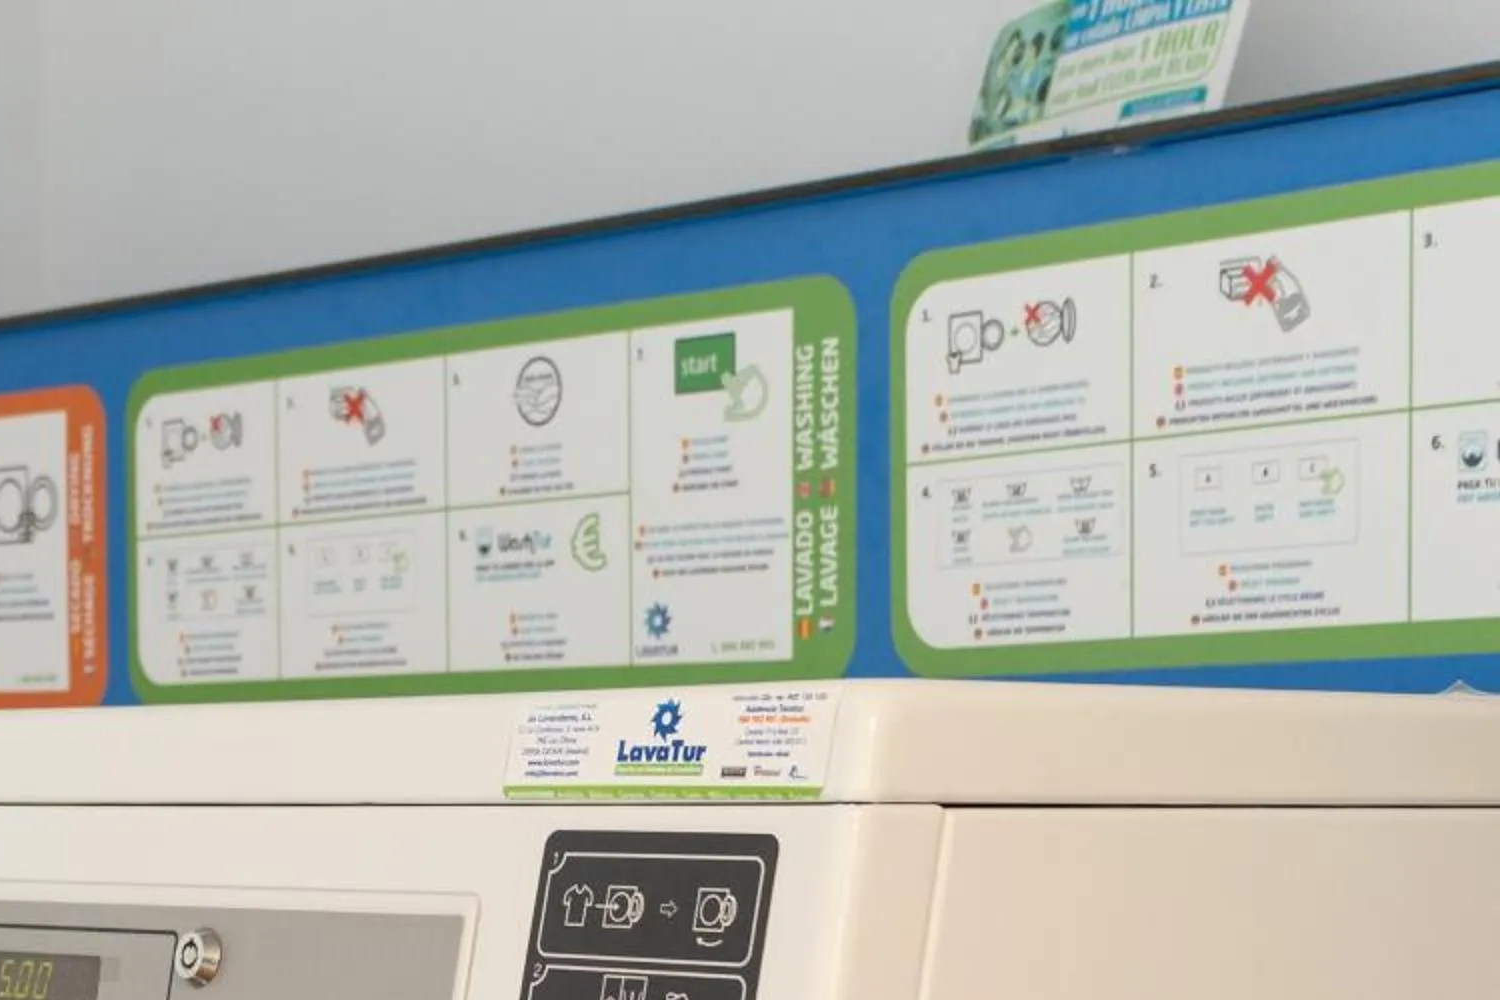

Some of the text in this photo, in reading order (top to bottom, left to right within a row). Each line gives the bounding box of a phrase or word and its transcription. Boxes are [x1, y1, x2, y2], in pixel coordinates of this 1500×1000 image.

[680, 352, 718, 377] start
[796, 343, 815, 471] WASHING
[796, 508, 814, 615] LAVADO
[820, 503, 839, 607] LAVAGE
[617, 740, 706, 761] LavaTur
[533, 964, 544, 977] 2
